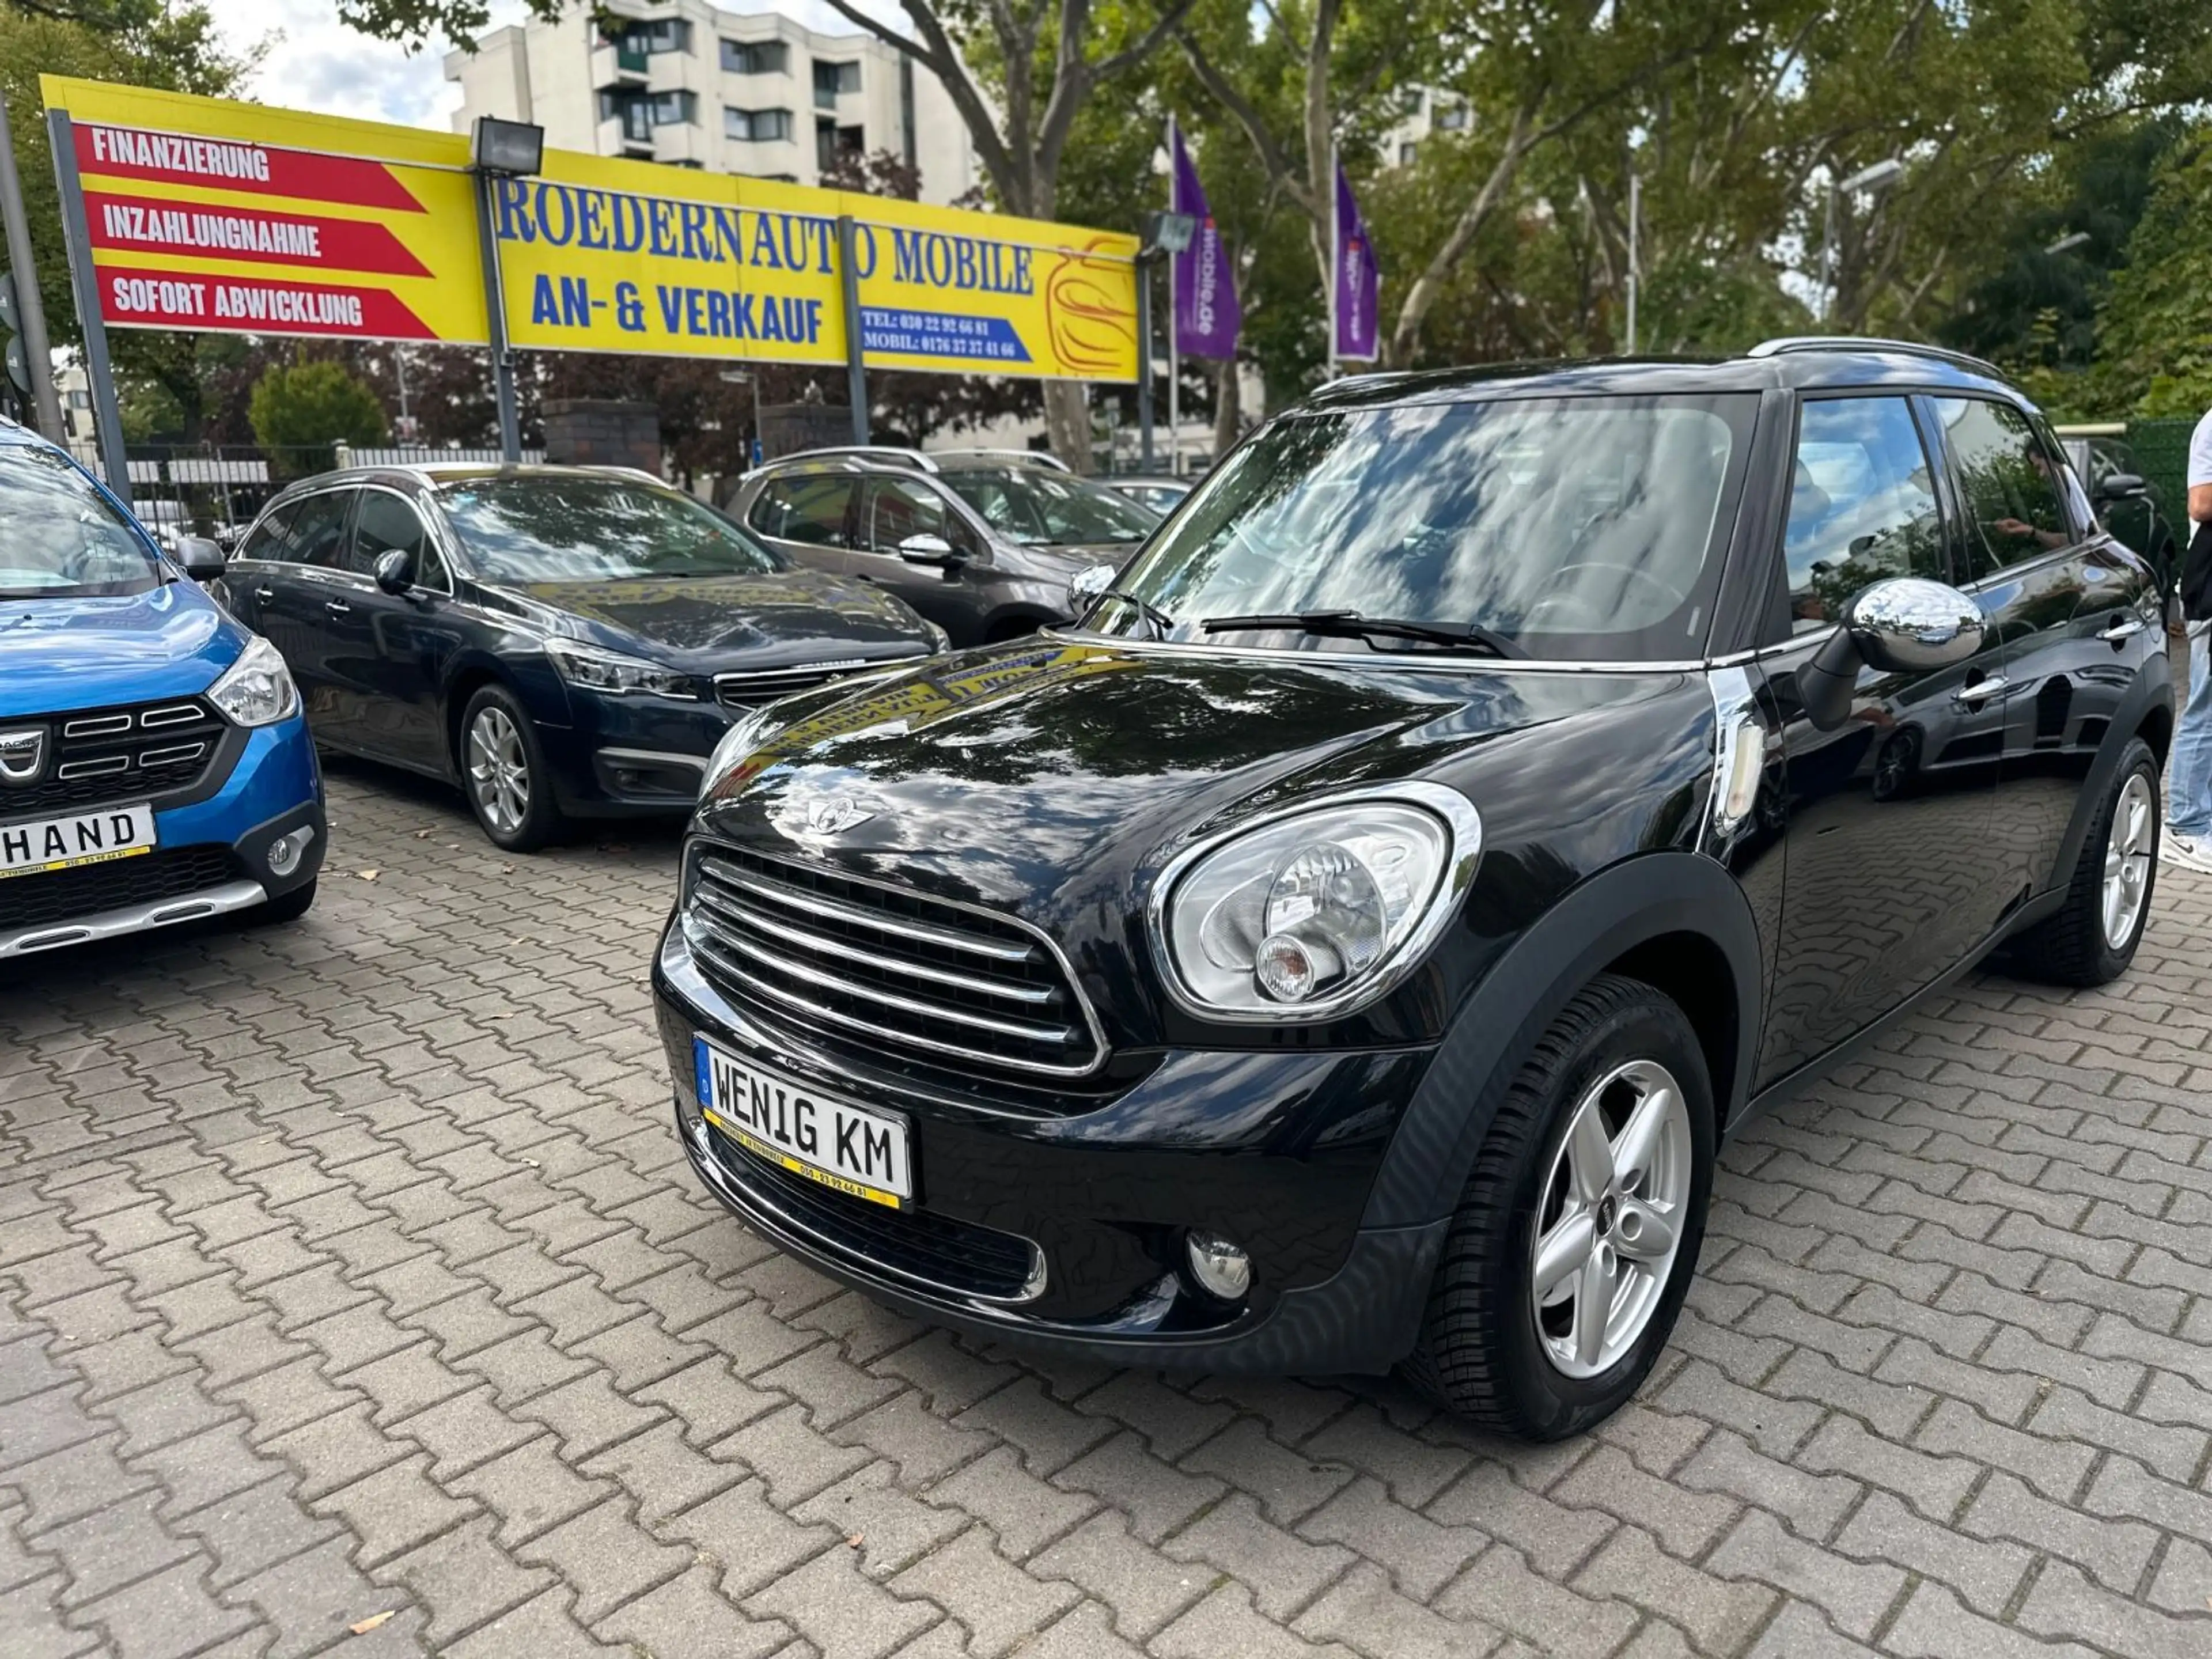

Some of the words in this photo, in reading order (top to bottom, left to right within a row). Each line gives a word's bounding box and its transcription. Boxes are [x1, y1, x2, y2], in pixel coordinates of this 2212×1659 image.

[92, 128, 270, 182] FINANZIERUNG
[103, 204, 322, 257] INZAHLUNGNAHME
[498, 177, 743, 265] ROEDERN
[891, 228, 1034, 296] MOBILE
[113, 277, 205, 316] SOFORT
[215, 285, 362, 327] ABWICKLUNG
[1199, 228, 1218, 335] mobile.de
[532, 274, 607, 327] AN-
[615, 281, 647, 333] &
[656, 285, 823, 344] VERKAUF
[861, 310, 898, 328] TEL:
[863, 332, 919, 351] MOBIL:
[2, 813, 135, 864] HAND
[714, 1057, 818, 1156] WENIG
[836, 1112, 893, 1183] KM
